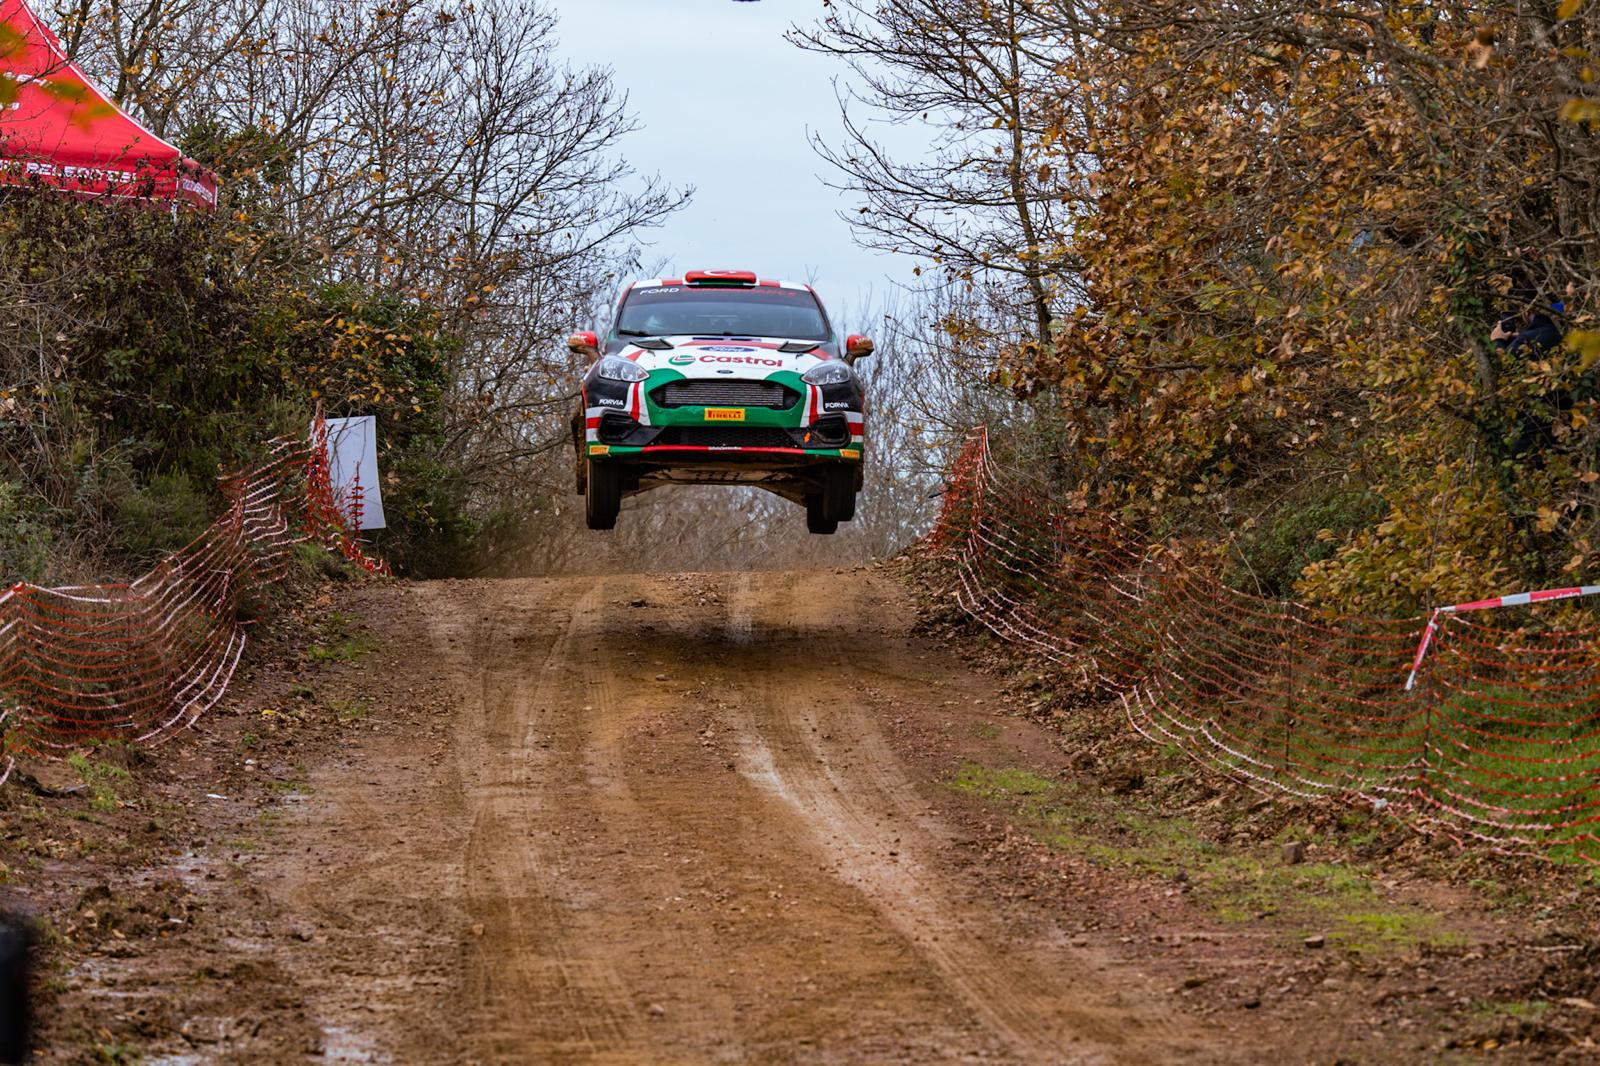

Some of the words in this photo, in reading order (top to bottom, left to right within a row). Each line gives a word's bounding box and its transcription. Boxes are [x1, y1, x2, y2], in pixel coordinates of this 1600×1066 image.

[639, 287, 680, 296] FORD
[699, 355, 783, 367] Castrol
[599, 398, 624, 406] FORVIA
